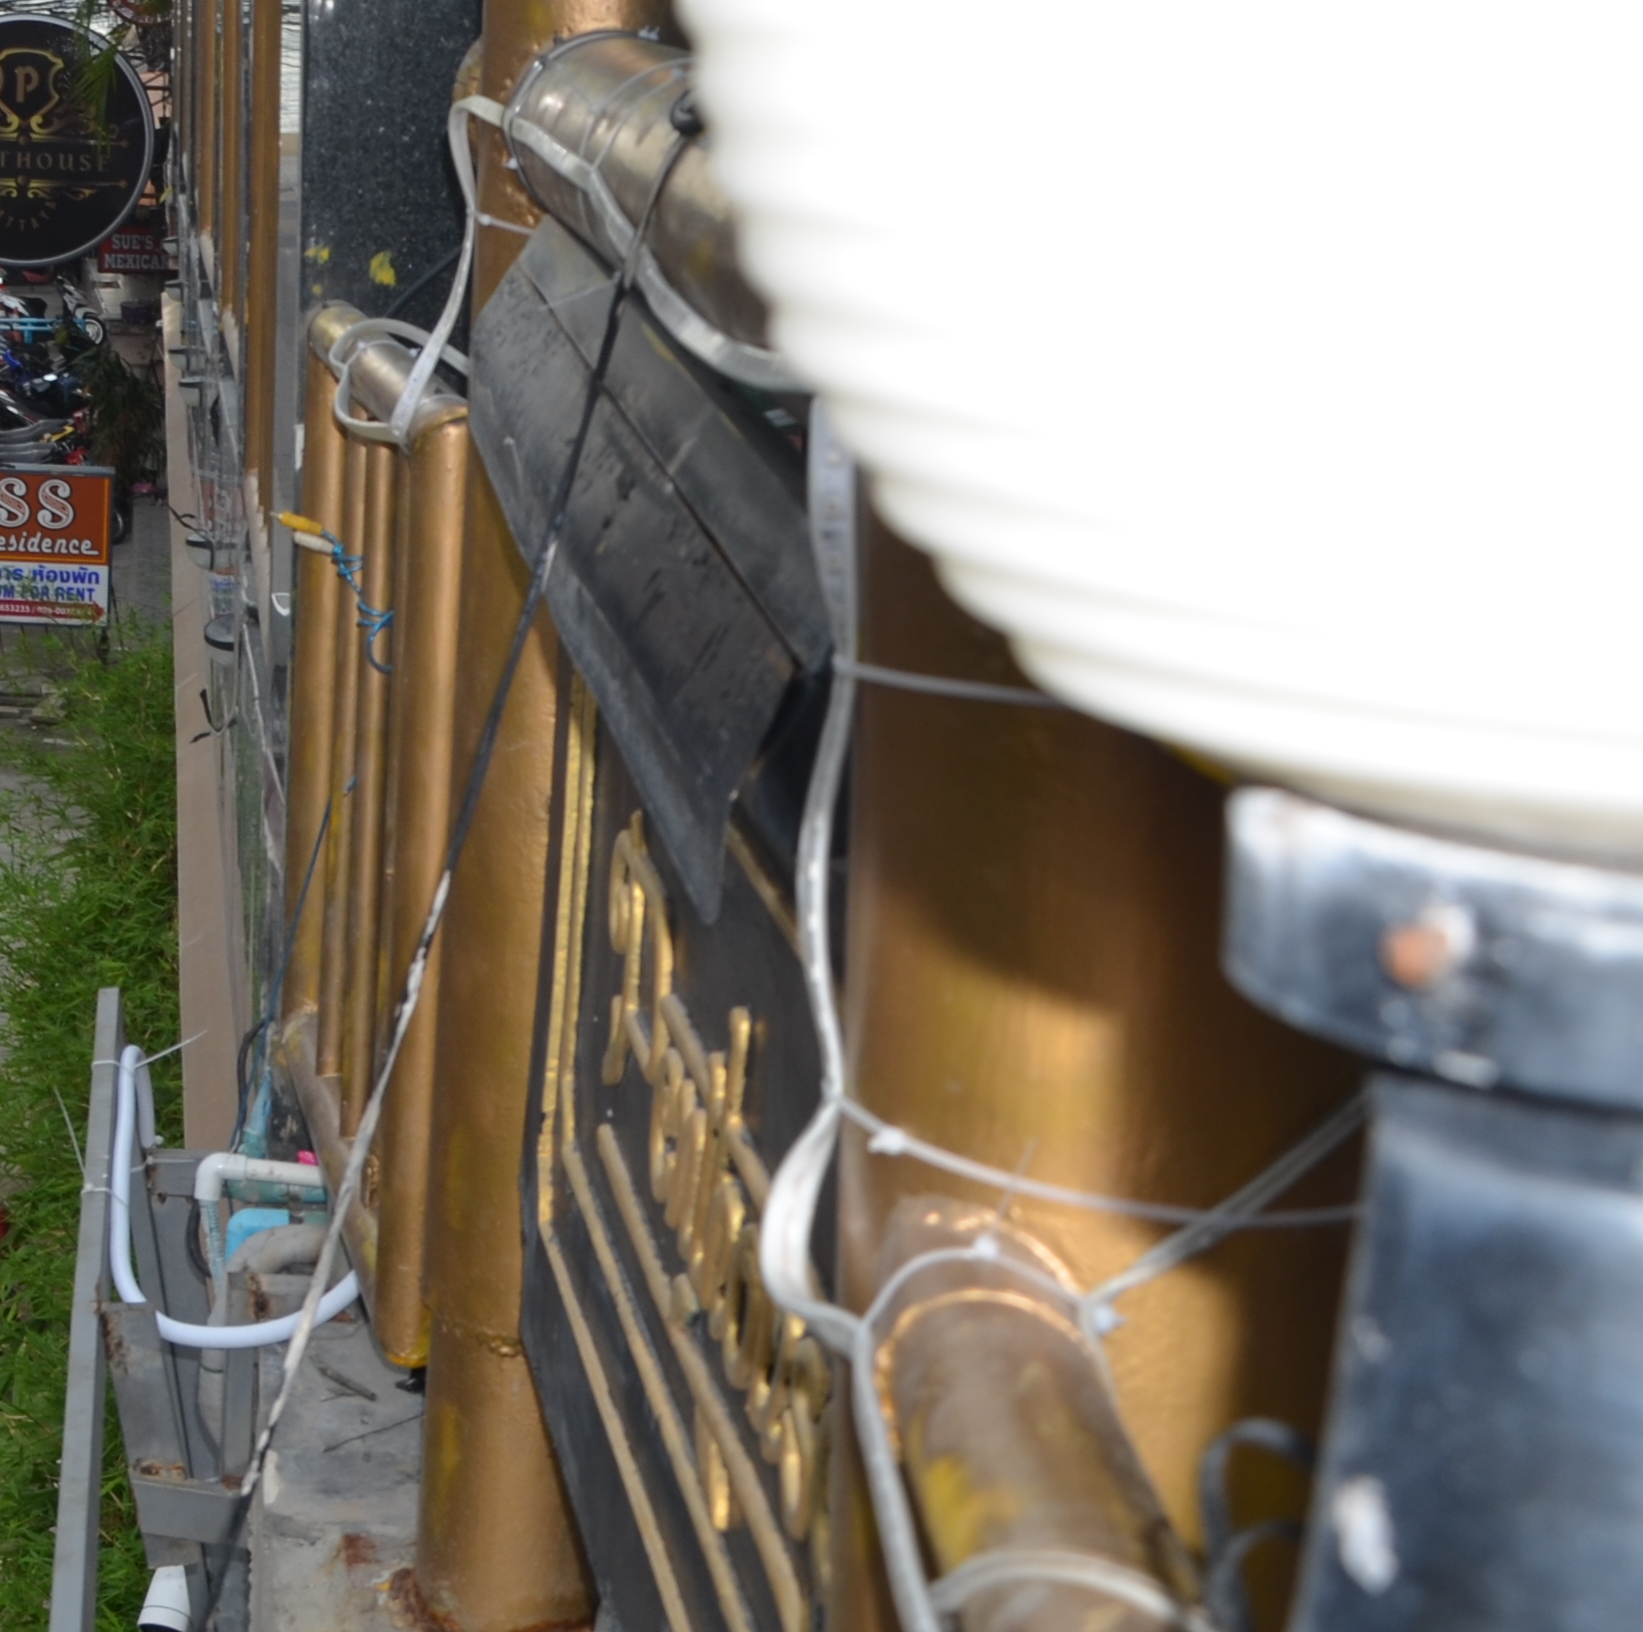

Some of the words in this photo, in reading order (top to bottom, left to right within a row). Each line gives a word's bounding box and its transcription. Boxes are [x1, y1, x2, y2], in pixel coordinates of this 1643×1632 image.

[16, 66, 40, 103] P
[112, 234, 154, 250] SUE'S
[32, 565, 100, 585] ห้องพัก
[55, 587, 96, 602] RENT
